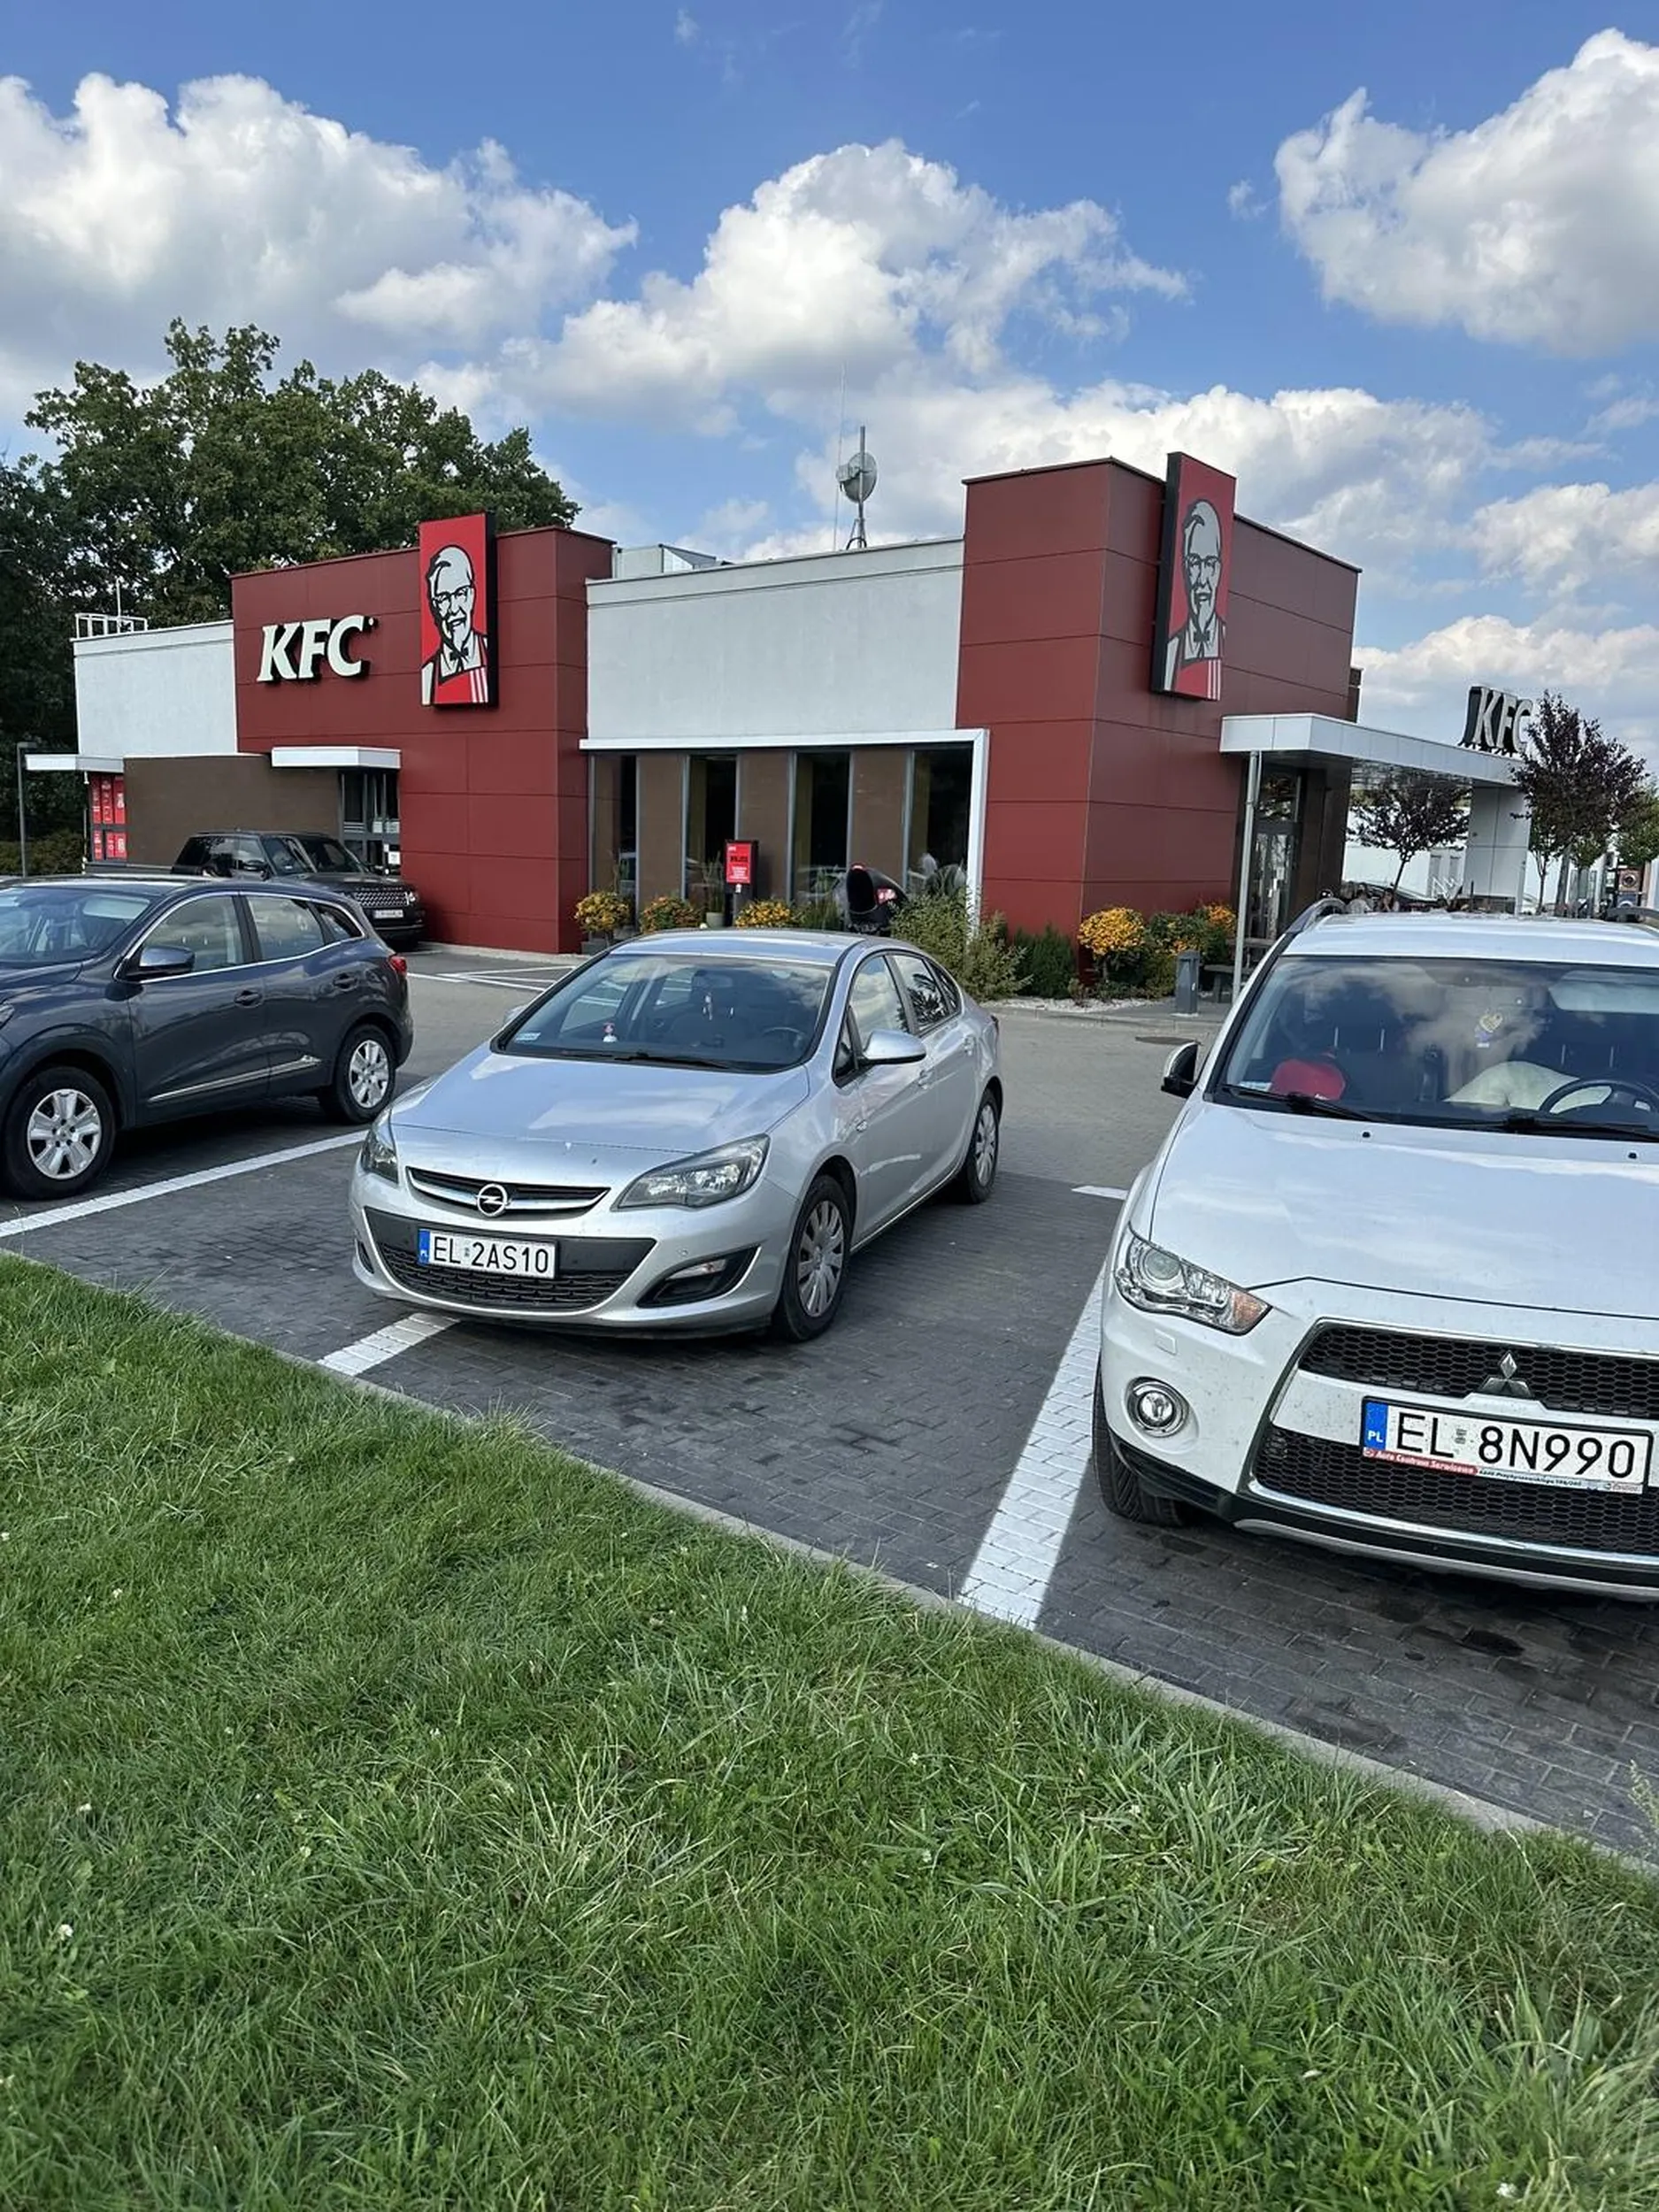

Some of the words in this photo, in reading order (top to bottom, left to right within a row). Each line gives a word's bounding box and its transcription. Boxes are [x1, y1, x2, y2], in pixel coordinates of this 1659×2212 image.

[256, 614, 365, 681] KFC
[1471, 687, 1533, 752] KFC
[434, 1236, 461, 1263] EL
[471, 1241, 549, 1273] 2AS10
[1367, 1430, 1384, 1443] PL
[1375, 1451, 1395, 1462] Auto
[1396, 1455, 1430, 1467] Centrum
[1397, 1412, 1454, 1458] EL
[1479, 1425, 1635, 1479] 8N990
